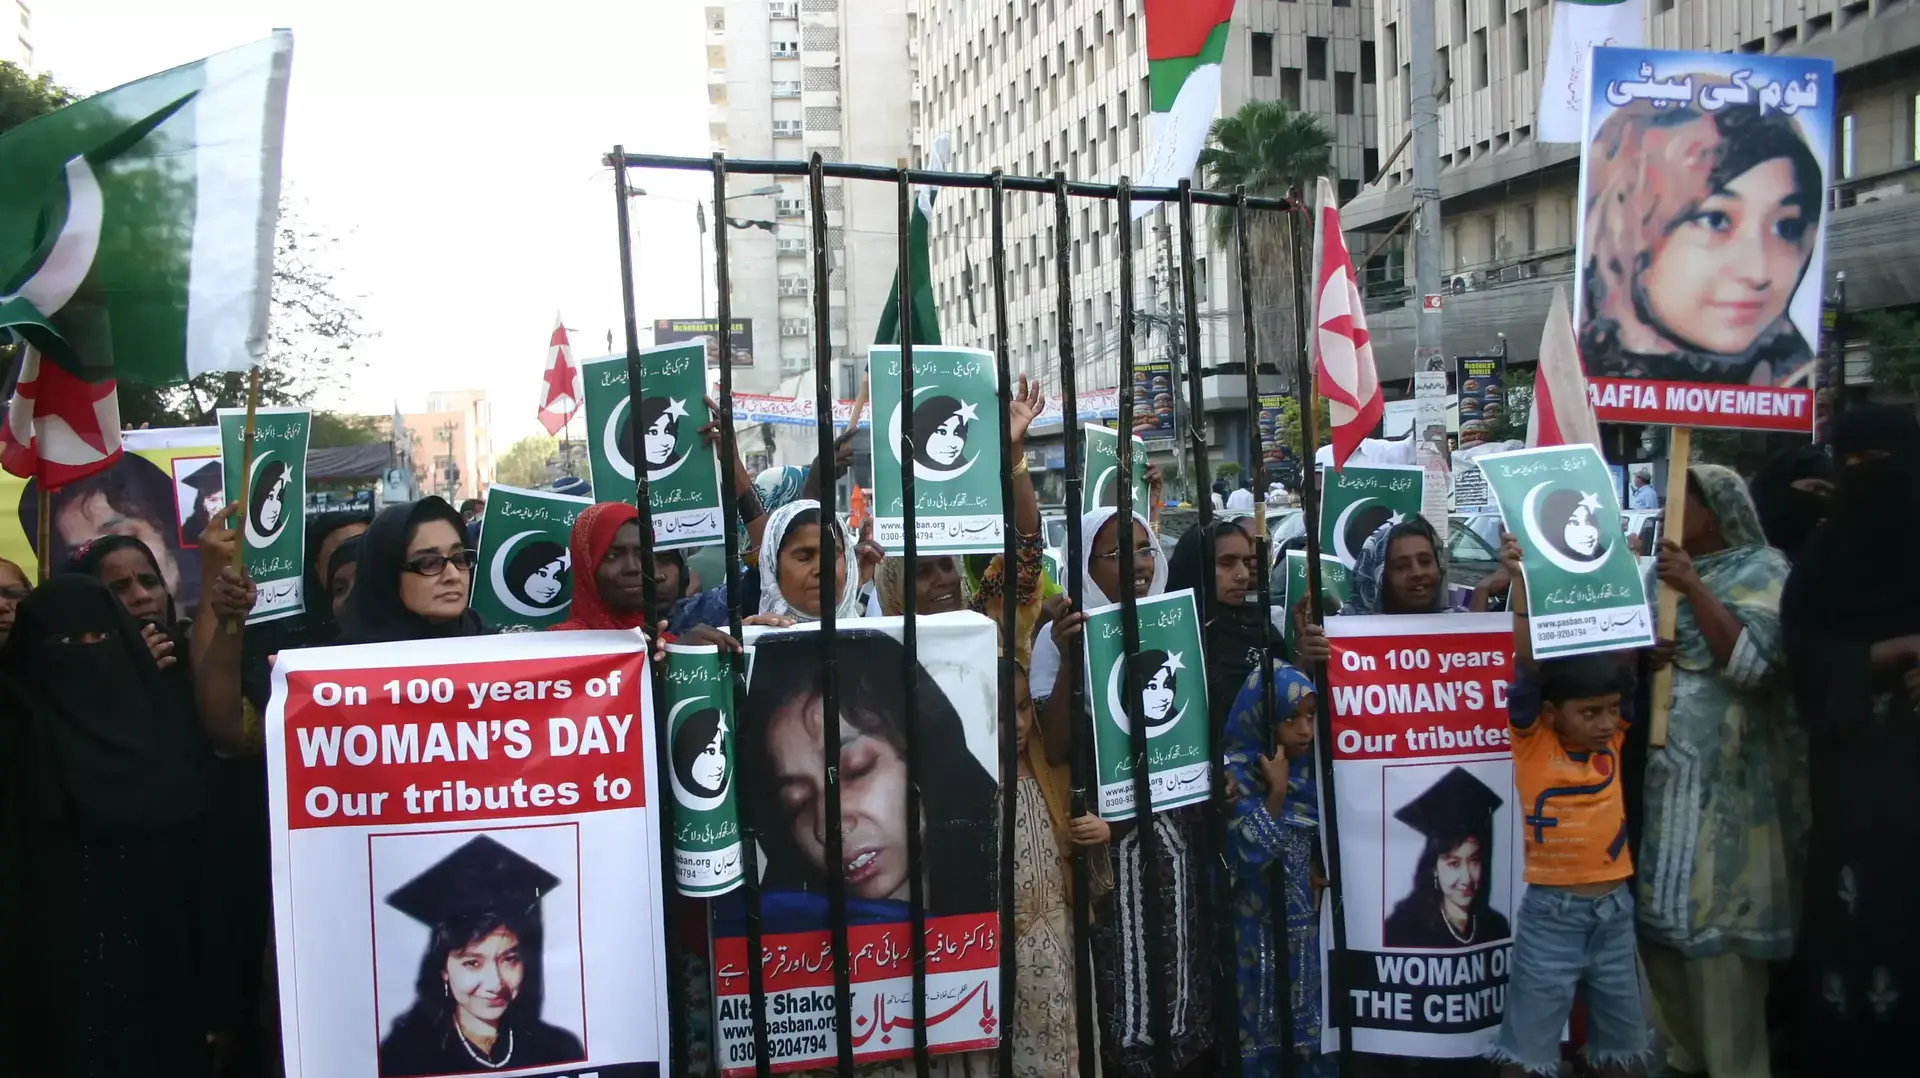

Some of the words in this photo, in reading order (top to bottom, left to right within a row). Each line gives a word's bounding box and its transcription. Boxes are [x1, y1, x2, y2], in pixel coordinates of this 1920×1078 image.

[1606, 61, 1692, 107] بیٹی
[1700, 68, 1753, 109] کی
[1759, 72, 1818, 116] قوم
[1589, 383, 1658, 409] AAFIA
[1665, 387, 1808, 417] MOVEMENT
[880, 521, 945, 531] www.ban.org
[1537, 616, 1597, 630] www.pasban.org
[1342, 650, 1377, 671] On
[1385, 648, 1430, 670] 100
[1437, 650, 1505, 674] years
[313, 682, 367, 706] On
[383, 677, 454, 704] 100
[468, 677, 573, 709] years
[585, 670, 622, 697] of
[1332, 680, 1484, 716] WOMAN'S
[296, 718, 532, 767] WOMAN'S
[549, 714, 634, 757] DAY
[1337, 729, 1397, 753] Our
[305, 785, 389, 818] Our
[403, 777, 580, 815] tributes
[593, 773, 632, 802] to
[926, 933, 958, 962] عافیہ
[957, 923, 994, 959] ڈاکٹر
[718, 963, 745, 986] ہے
[854, 943, 875, 976] ہم
[1375, 952, 1486, 987] WOMAN
[773, 990, 856, 1015] Shakor
[1350, 988, 1413, 1021] THE
[1423, 984, 1508, 1023] CENTU
[730, 1034, 827, 1063] 0309204794
